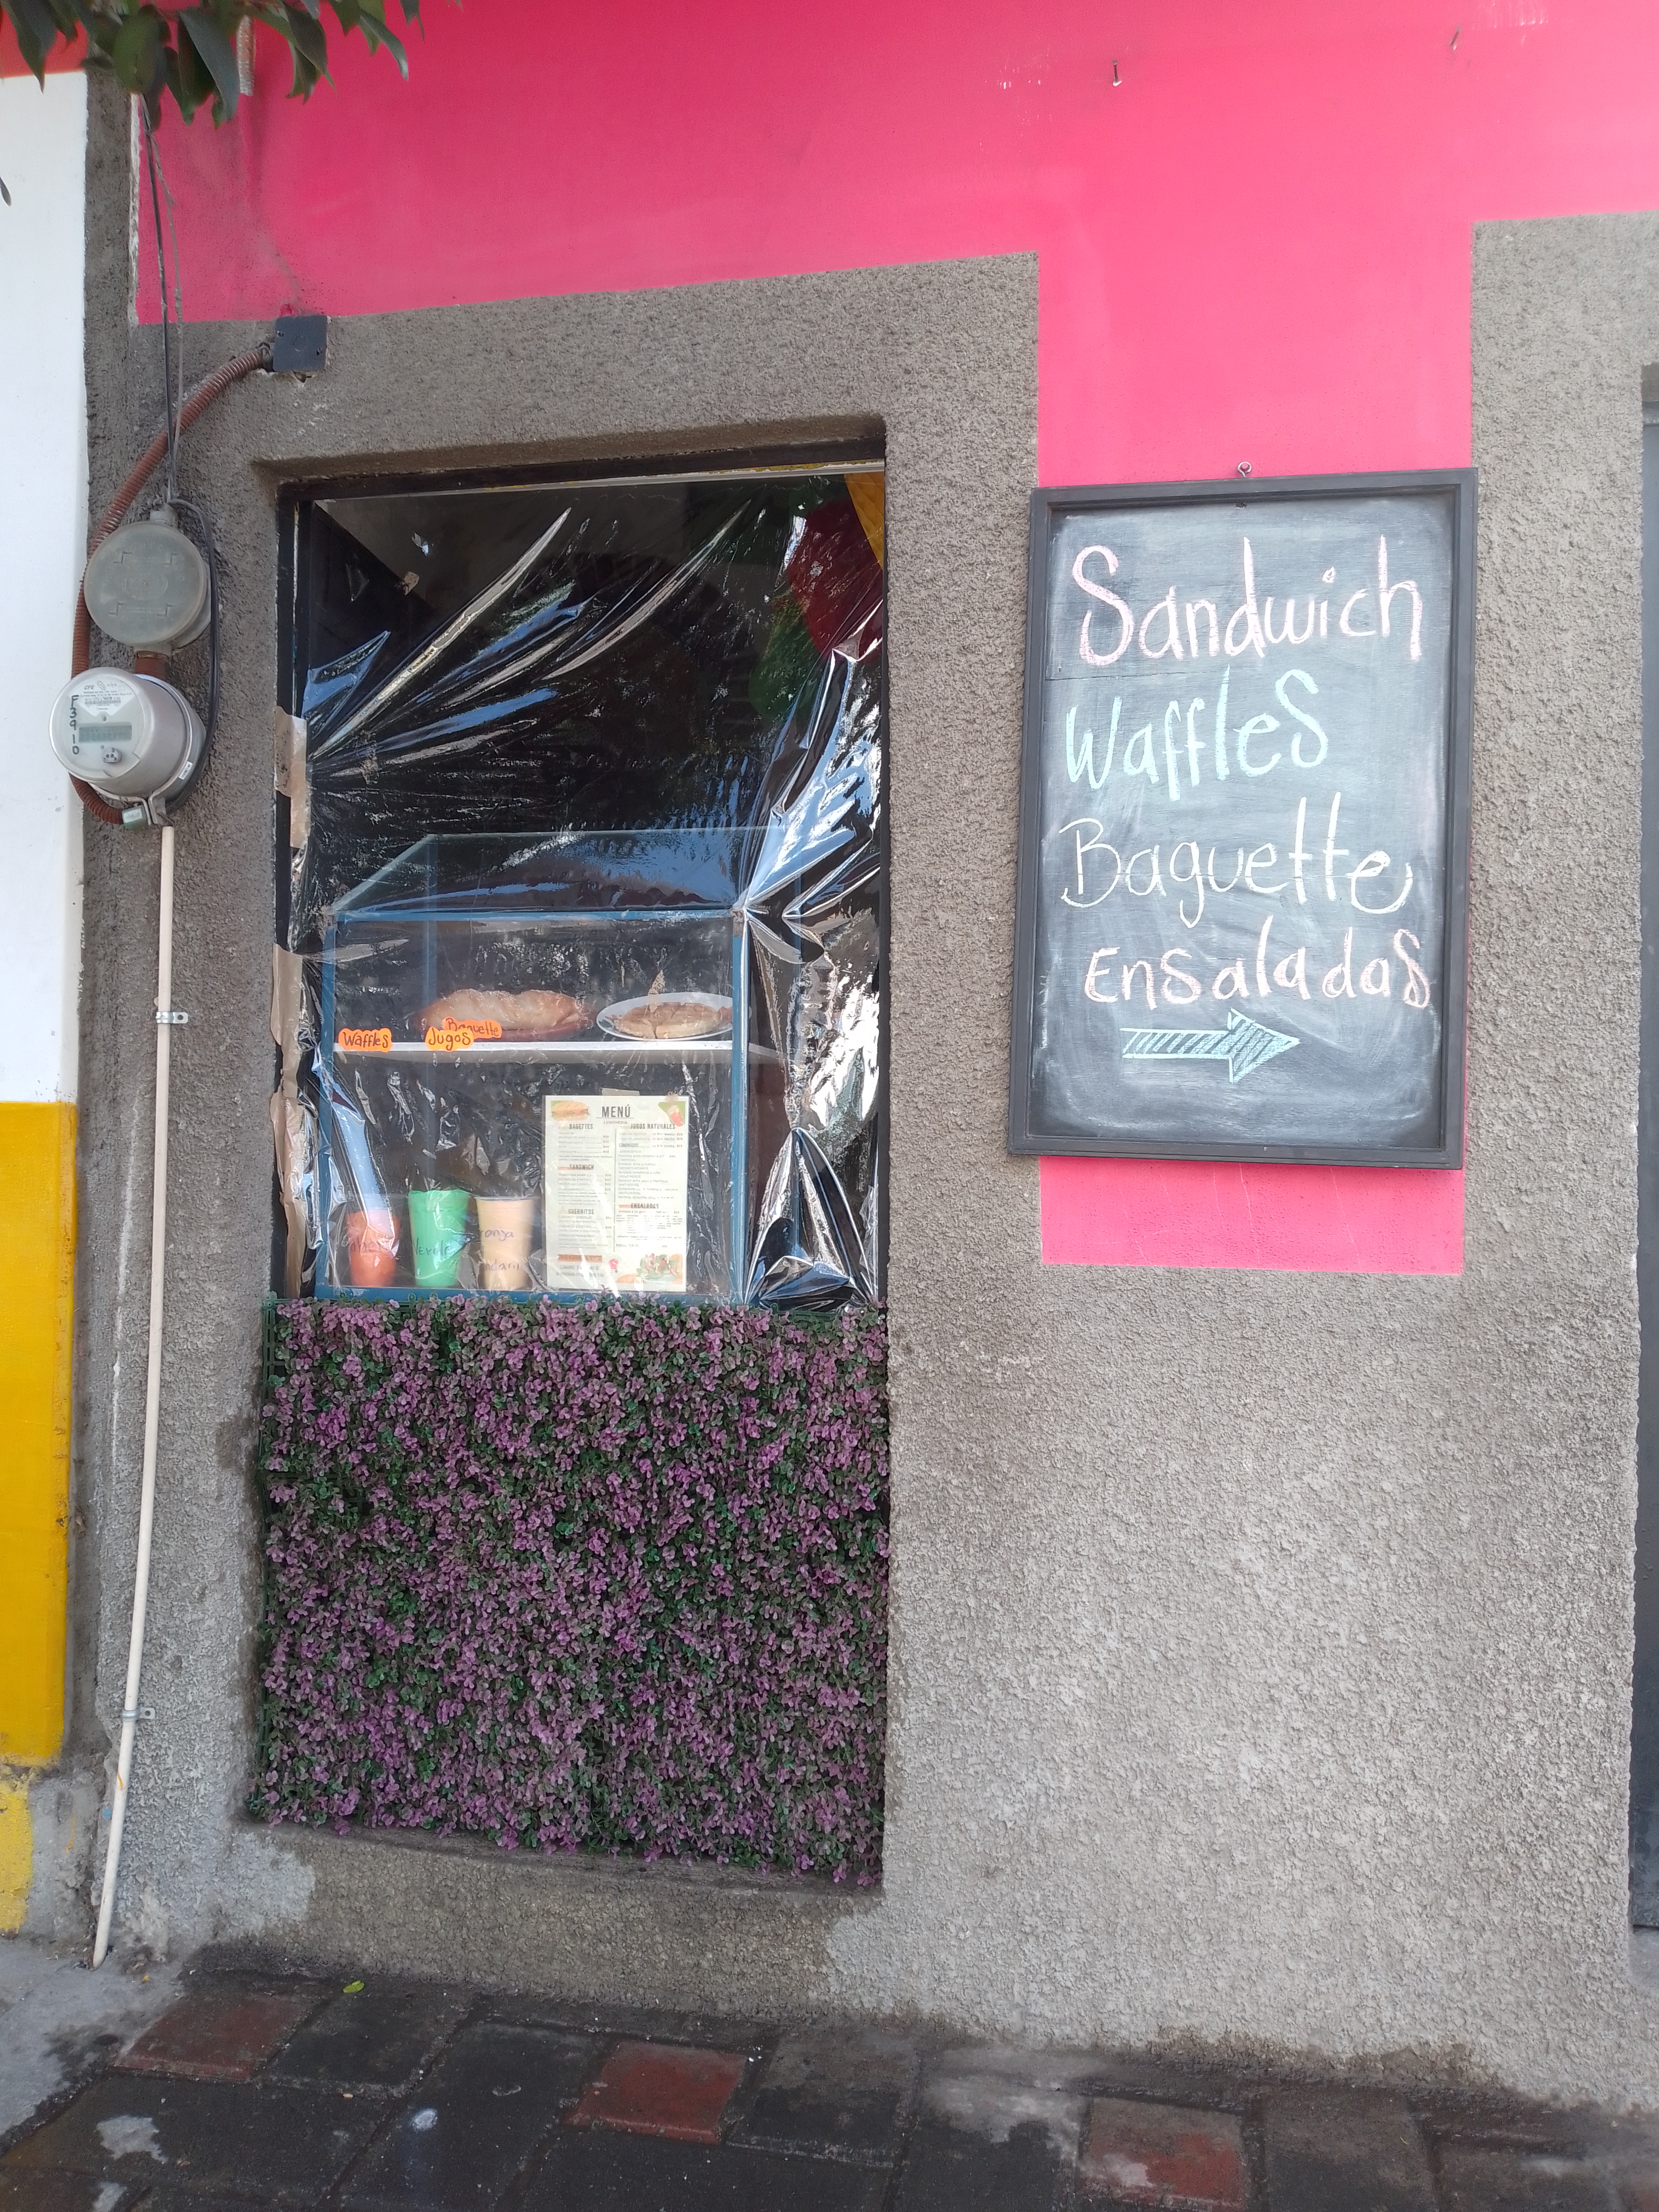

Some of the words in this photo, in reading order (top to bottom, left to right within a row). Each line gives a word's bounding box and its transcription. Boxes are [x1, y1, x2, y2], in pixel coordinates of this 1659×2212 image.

[1071, 534, 1422, 667] Sandwich
[1059, 792, 1414, 928] Baguette
[428, 1027, 471, 1051] Jugos
[601, 1104, 630, 1118] MENÚ
